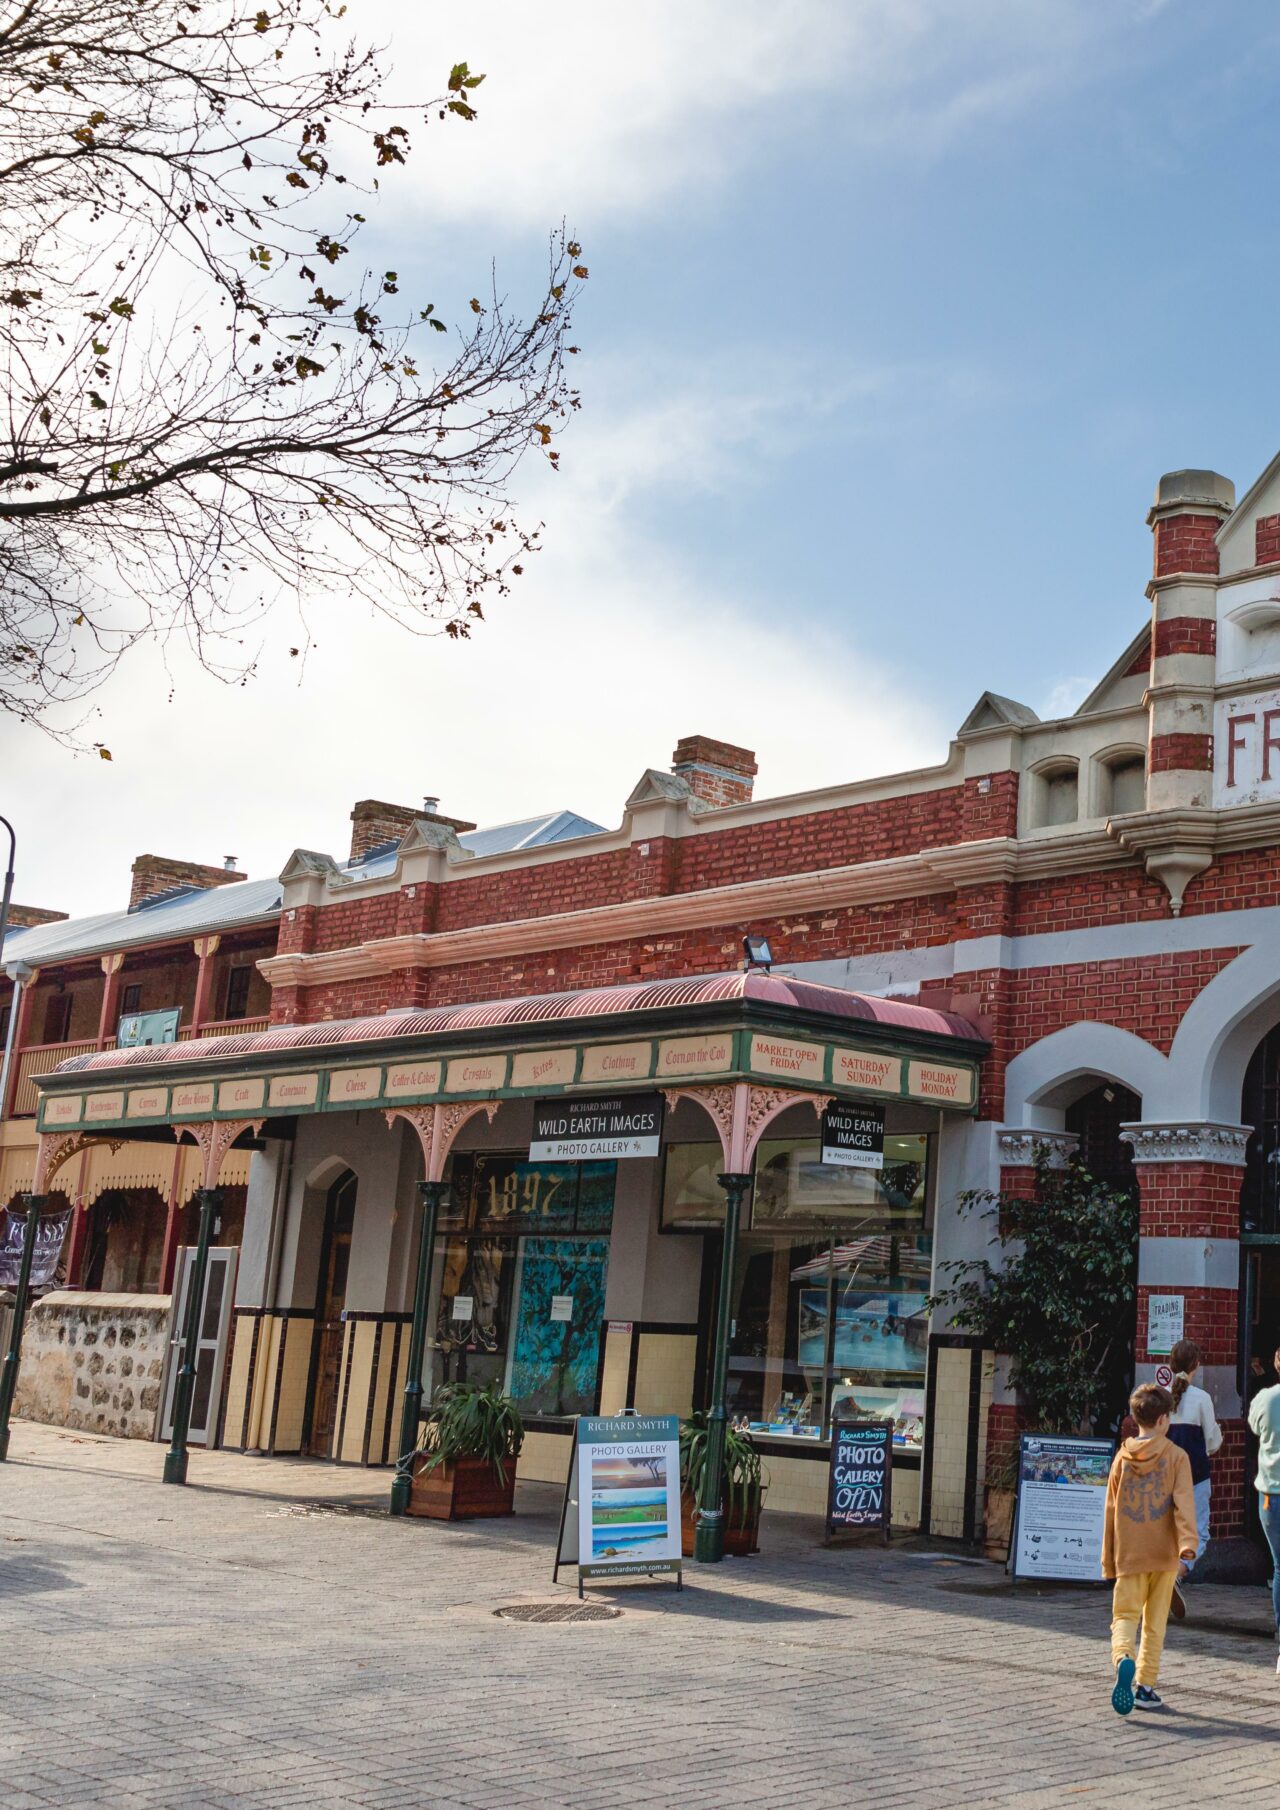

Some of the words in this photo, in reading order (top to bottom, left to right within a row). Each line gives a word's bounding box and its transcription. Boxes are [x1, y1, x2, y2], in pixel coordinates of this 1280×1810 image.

[697, 1048, 709, 1062] the
[756, 1043, 795, 1058] MARKET
[795, 1049, 818, 1062] OPEN
[602, 1055, 636, 1071] Clothing
[770, 1056, 802, 1071] FRIDAY
[841, 1057, 892, 1074] SATURDAY
[392, 1074, 410, 1087] Coffee
[417, 1071, 436, 1085] Cakes
[462, 1066, 492, 1081] Crystals
[847, 1071, 885, 1086] SUNDAY
[920, 1070, 958, 1085] HOLIDAY
[346, 1079, 367, 1092] Cheese
[921, 1083, 957, 1097] MONDAY
[570, 1102, 599, 1113] RICHARD
[600, 1101, 621, 1110] SMYTH
[539, 1119, 567, 1135] WILD
[570, 1117, 606, 1134] EARTH
[610, 1114, 654, 1131] IMAGES
[827, 1115, 852, 1129] WILD
[855, 1120, 883, 1133] EARTH
[838, 1132, 872, 1147] IMAGES
[557, 1143, 588, 1155] PHOTO
[590, 1141, 629, 1153] GALLERY
[834, 1152, 852, 1160] PHOTO
[853, 1154, 874, 1163] GALLERY
[488, 1170, 564, 1217] 1897
[588, 1421, 634, 1432] RICHARD
[638, 1420, 670, 1430] SMYTH
[592, 1446, 624, 1456] PHOTO
[627, 1444, 667, 1455] GALLERY
[838, 1445, 885, 1464] PHOTO
[834, 1466, 884, 1484] GALLERY
[836, 1487, 882, 1510] OPEN
[590, 1564, 671, 1575] www.richardsmyth.com.au
